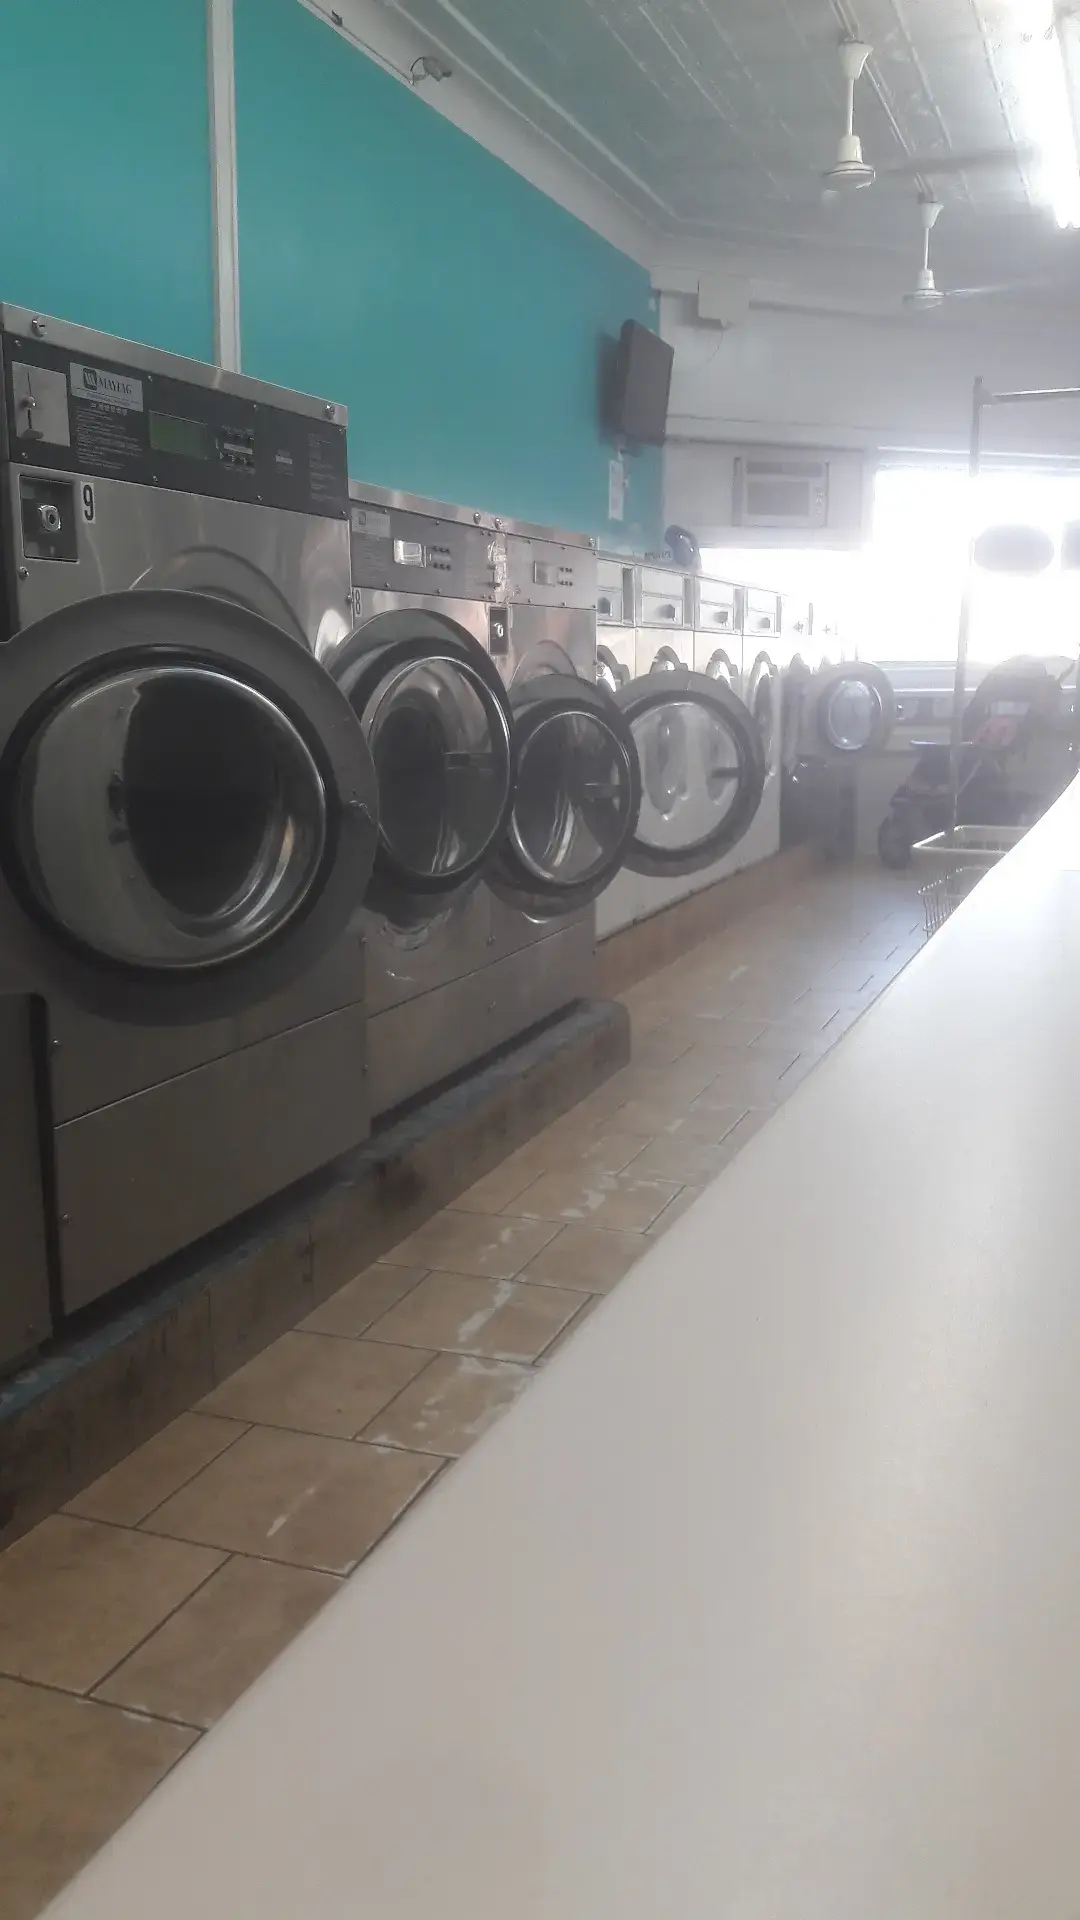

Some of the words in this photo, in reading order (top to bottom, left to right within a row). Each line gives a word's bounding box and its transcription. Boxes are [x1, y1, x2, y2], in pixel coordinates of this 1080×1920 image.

[97, 377, 132, 396] MAYTAG
[83, 484, 94, 521] 9
[355, 589, 361, 615] 8
